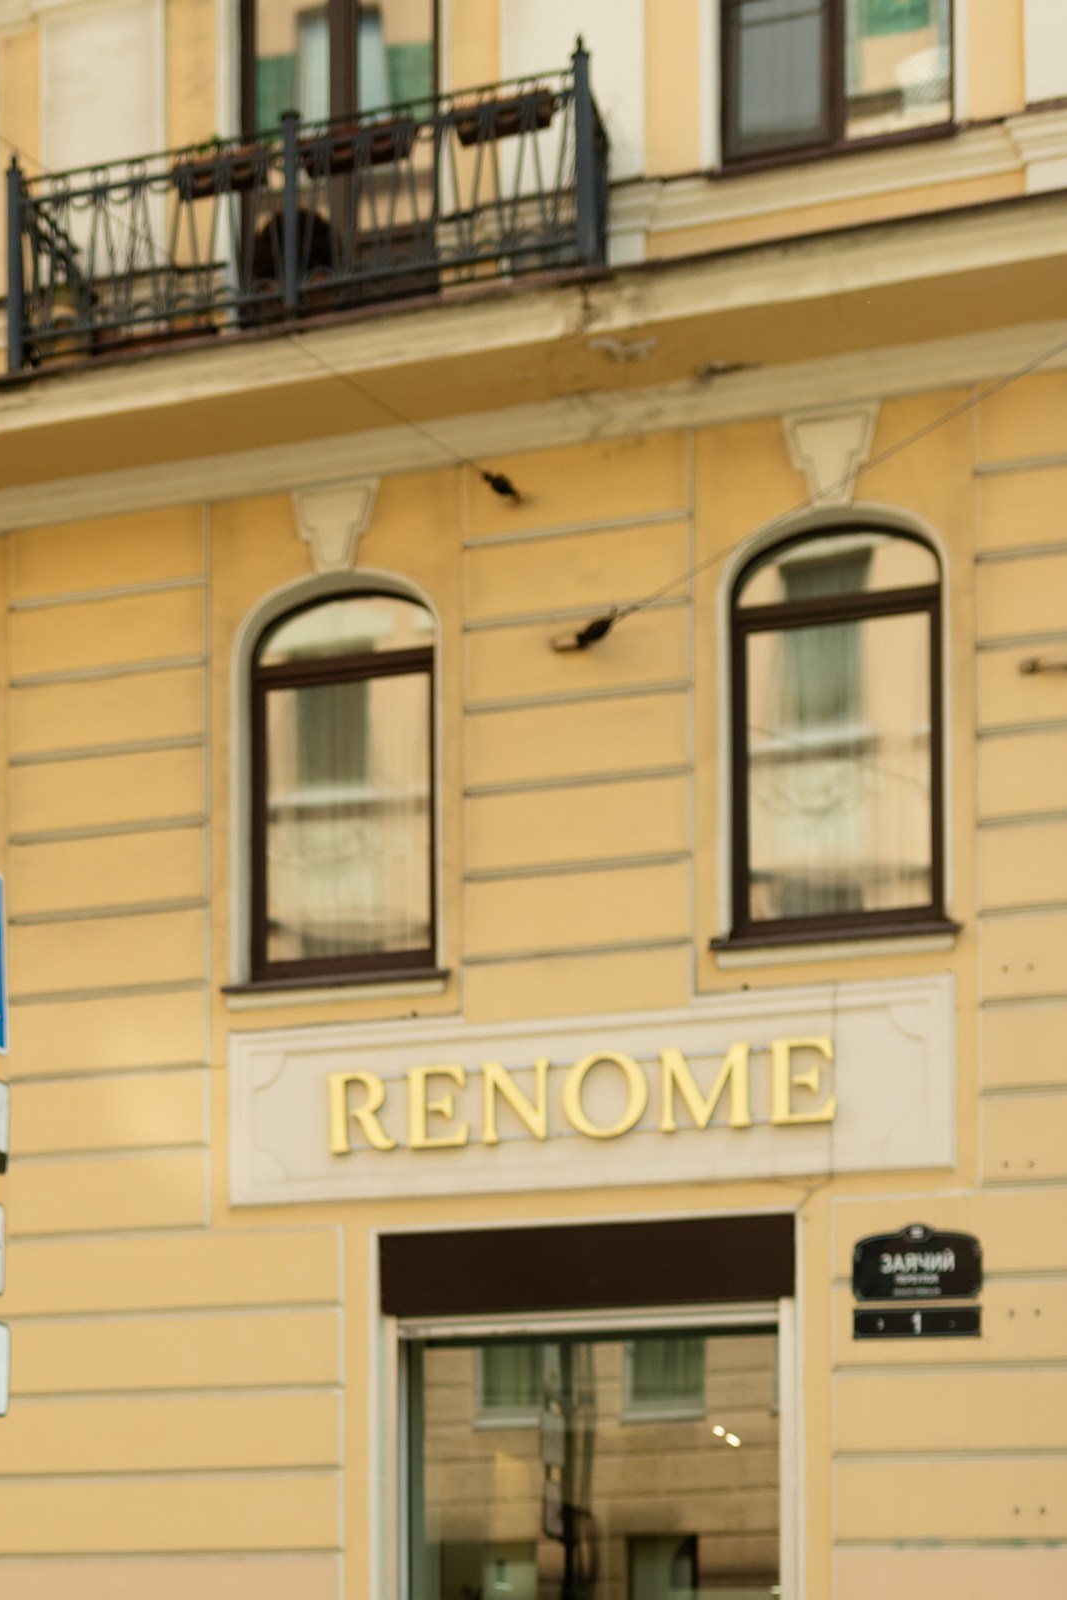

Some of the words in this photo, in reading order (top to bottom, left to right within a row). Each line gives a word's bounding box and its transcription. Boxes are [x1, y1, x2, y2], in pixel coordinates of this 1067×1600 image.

[327, 1036, 836, 1155] RENOME
[879, 1248, 955, 1274] ЗАЯЧИЙ
[911, 1310, 922, 1335] 1
